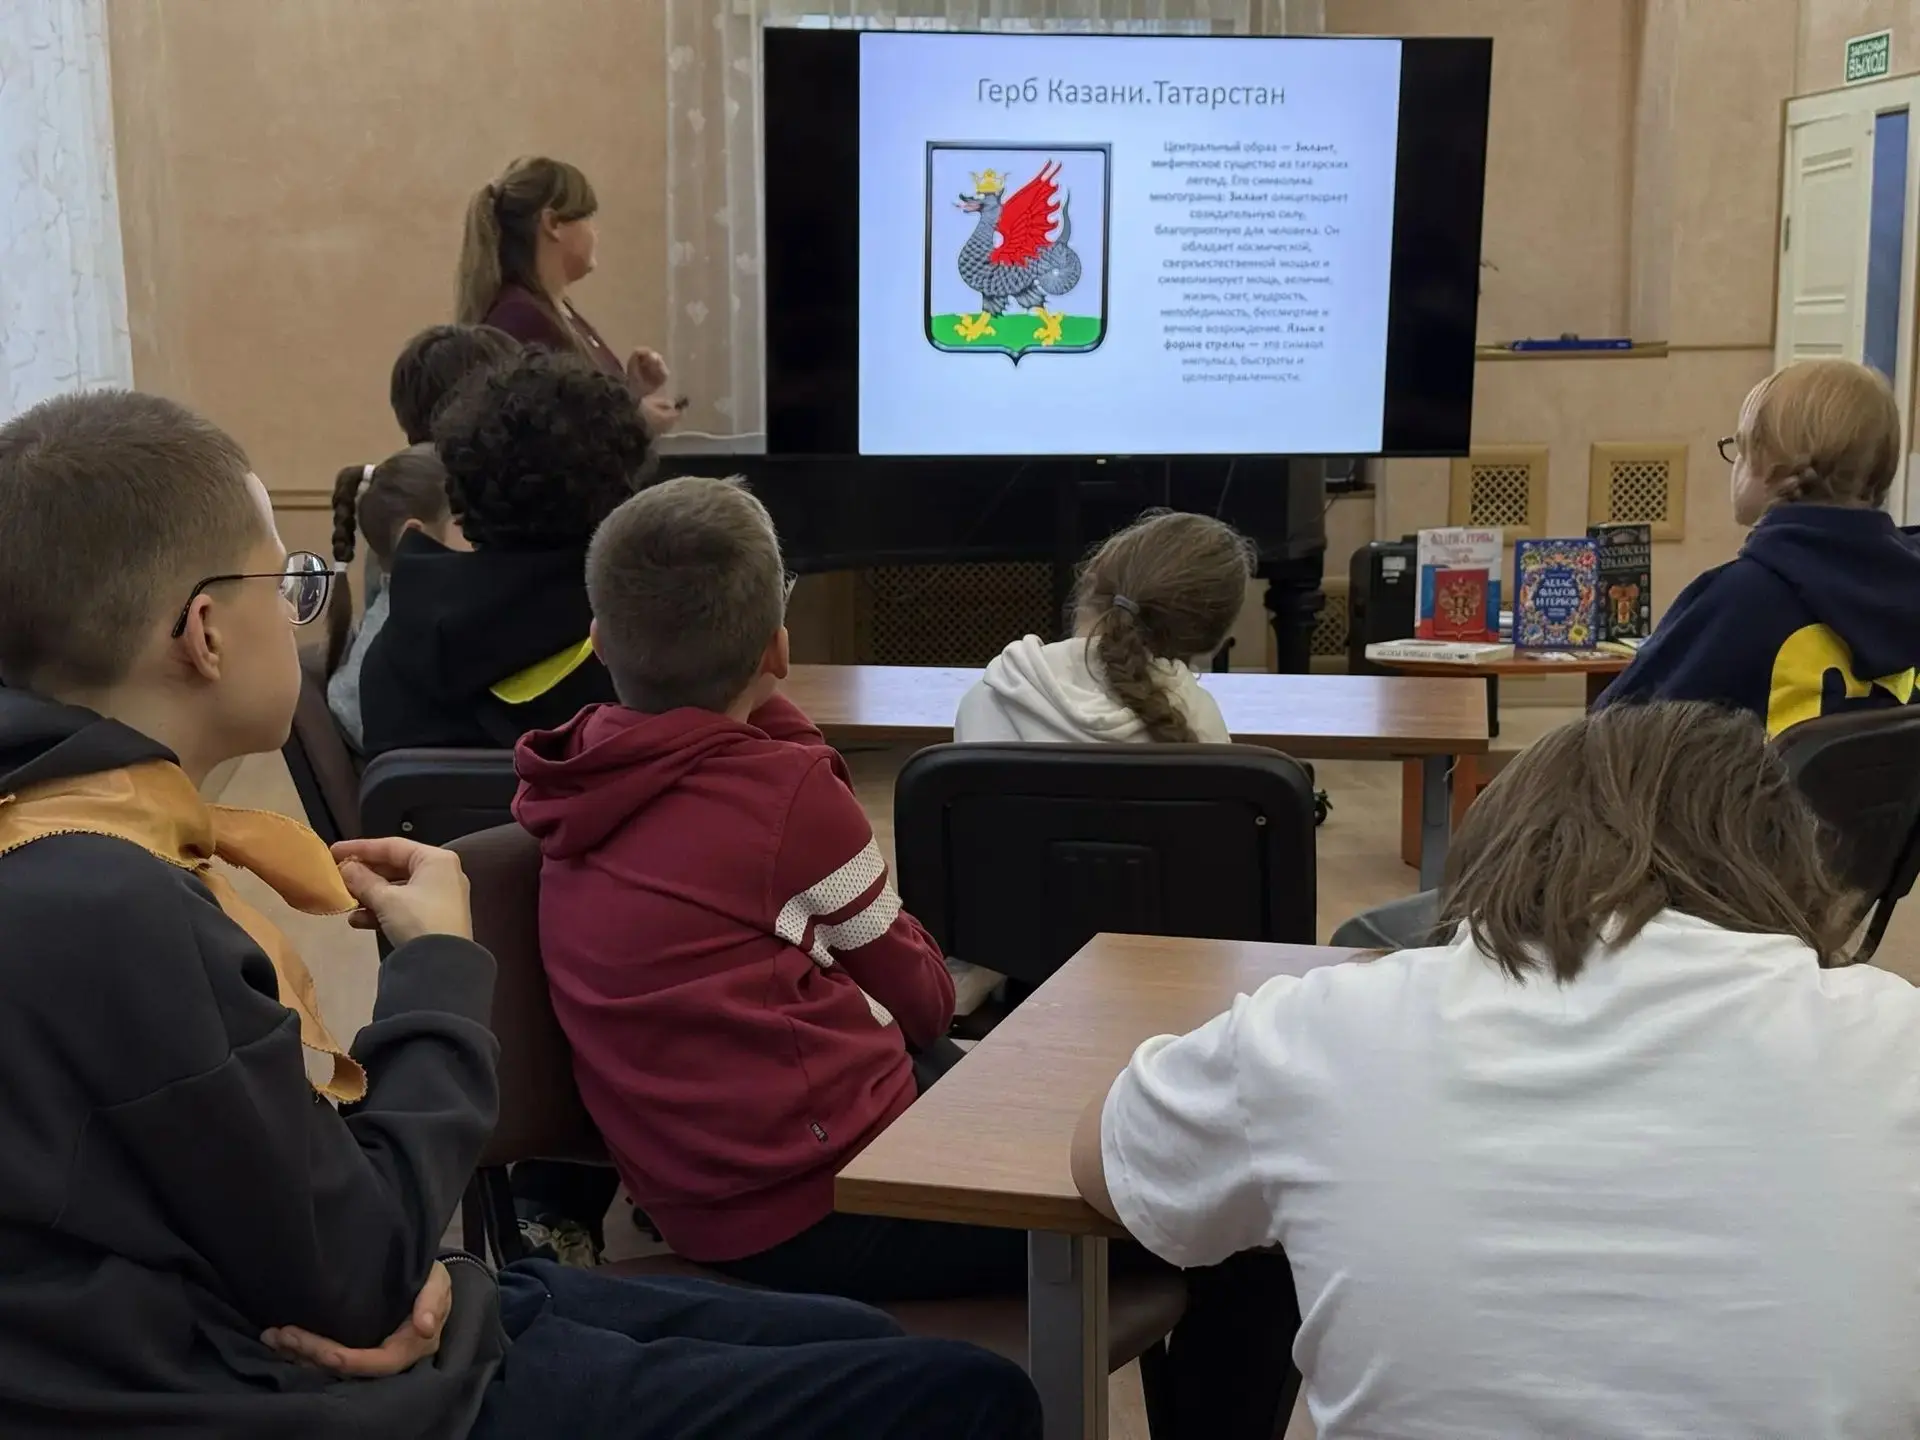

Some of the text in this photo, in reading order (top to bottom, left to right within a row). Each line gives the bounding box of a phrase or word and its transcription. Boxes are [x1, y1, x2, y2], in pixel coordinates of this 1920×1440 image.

[1849, 51, 1886, 78] ВЫХОД
[978, 77, 1285, 110] Герб Казани.Татарстан
[1164, 141, 1241, 154] Центральный
[1243, 142, 1277, 153] образ
[1151, 158, 1348, 171] мифическое существо из татарских
[1231, 176, 1249, 186] Его
[1252, 177, 1313, 186] символика
[1229, 192, 1268, 202] Зилант
[1271, 193, 1348, 204] олицетворяет
[1190, 209, 1276, 220] созидательную
[1155, 225, 1241, 237] благоприятную
[1244, 226, 1264, 236] для
[1324, 226, 1340, 235] Он
[1181, 241, 1234, 253] обладает
[1279, 259, 1320, 270] мощью
[1158, 275, 1244, 287] символизирует
[1253, 307, 1318, 319] бессмертие
[1164, 324, 1203, 333] вечное
[1287, 323, 1315, 333] Язык
[1164, 340, 1202, 351] форме
[1205, 341, 1245, 351] стрелы
[1282, 340, 1324, 350] символ
[1241, 356, 1294, 367] быстроты
